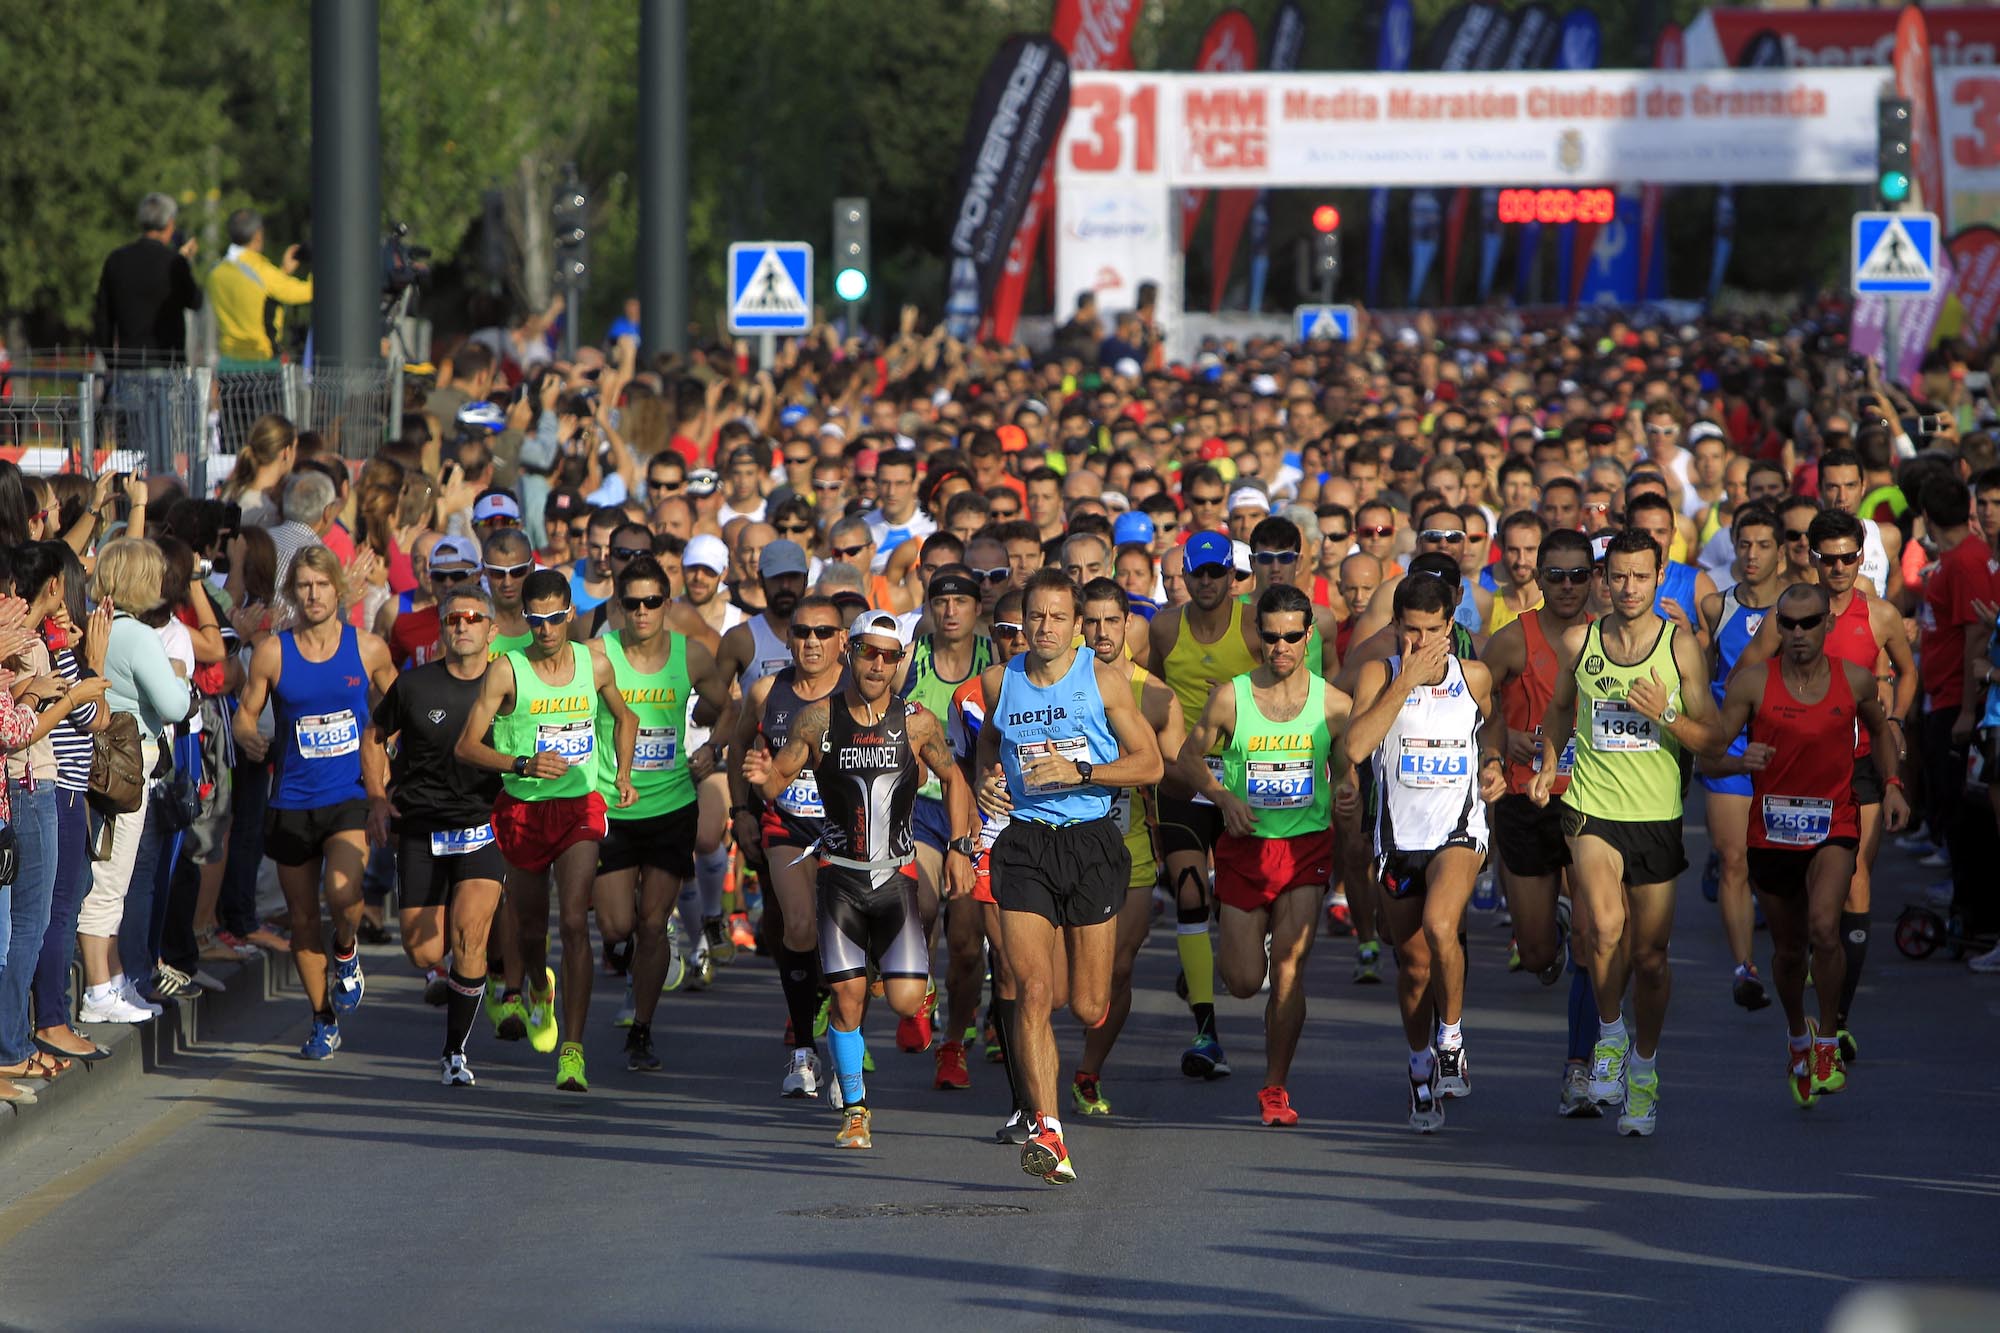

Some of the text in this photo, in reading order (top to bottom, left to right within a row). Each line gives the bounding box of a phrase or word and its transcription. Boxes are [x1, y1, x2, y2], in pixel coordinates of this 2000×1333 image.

[1284, 84, 1828, 121] Media Maratón Ciudad de Granada
[1069, 83, 1159, 174] 31
[951, 41, 1051, 256] POWERADE
[530, 696, 590, 715] BIKILA
[1009, 705, 1067, 726] nerja
[306, 727, 351, 746] 1285
[1018, 726, 1060, 738] ATLETISMO
[1602, 720, 1651, 735] 1364
[545, 736, 588, 754] 2363
[1248, 734, 1314, 752] BIKILA
[840, 746, 898, 770] FERNANDEZ
[1411, 756, 1460, 772] 1575
[1256, 779, 1305, 794] 2367
[1772, 815, 1819, 830] 2561
